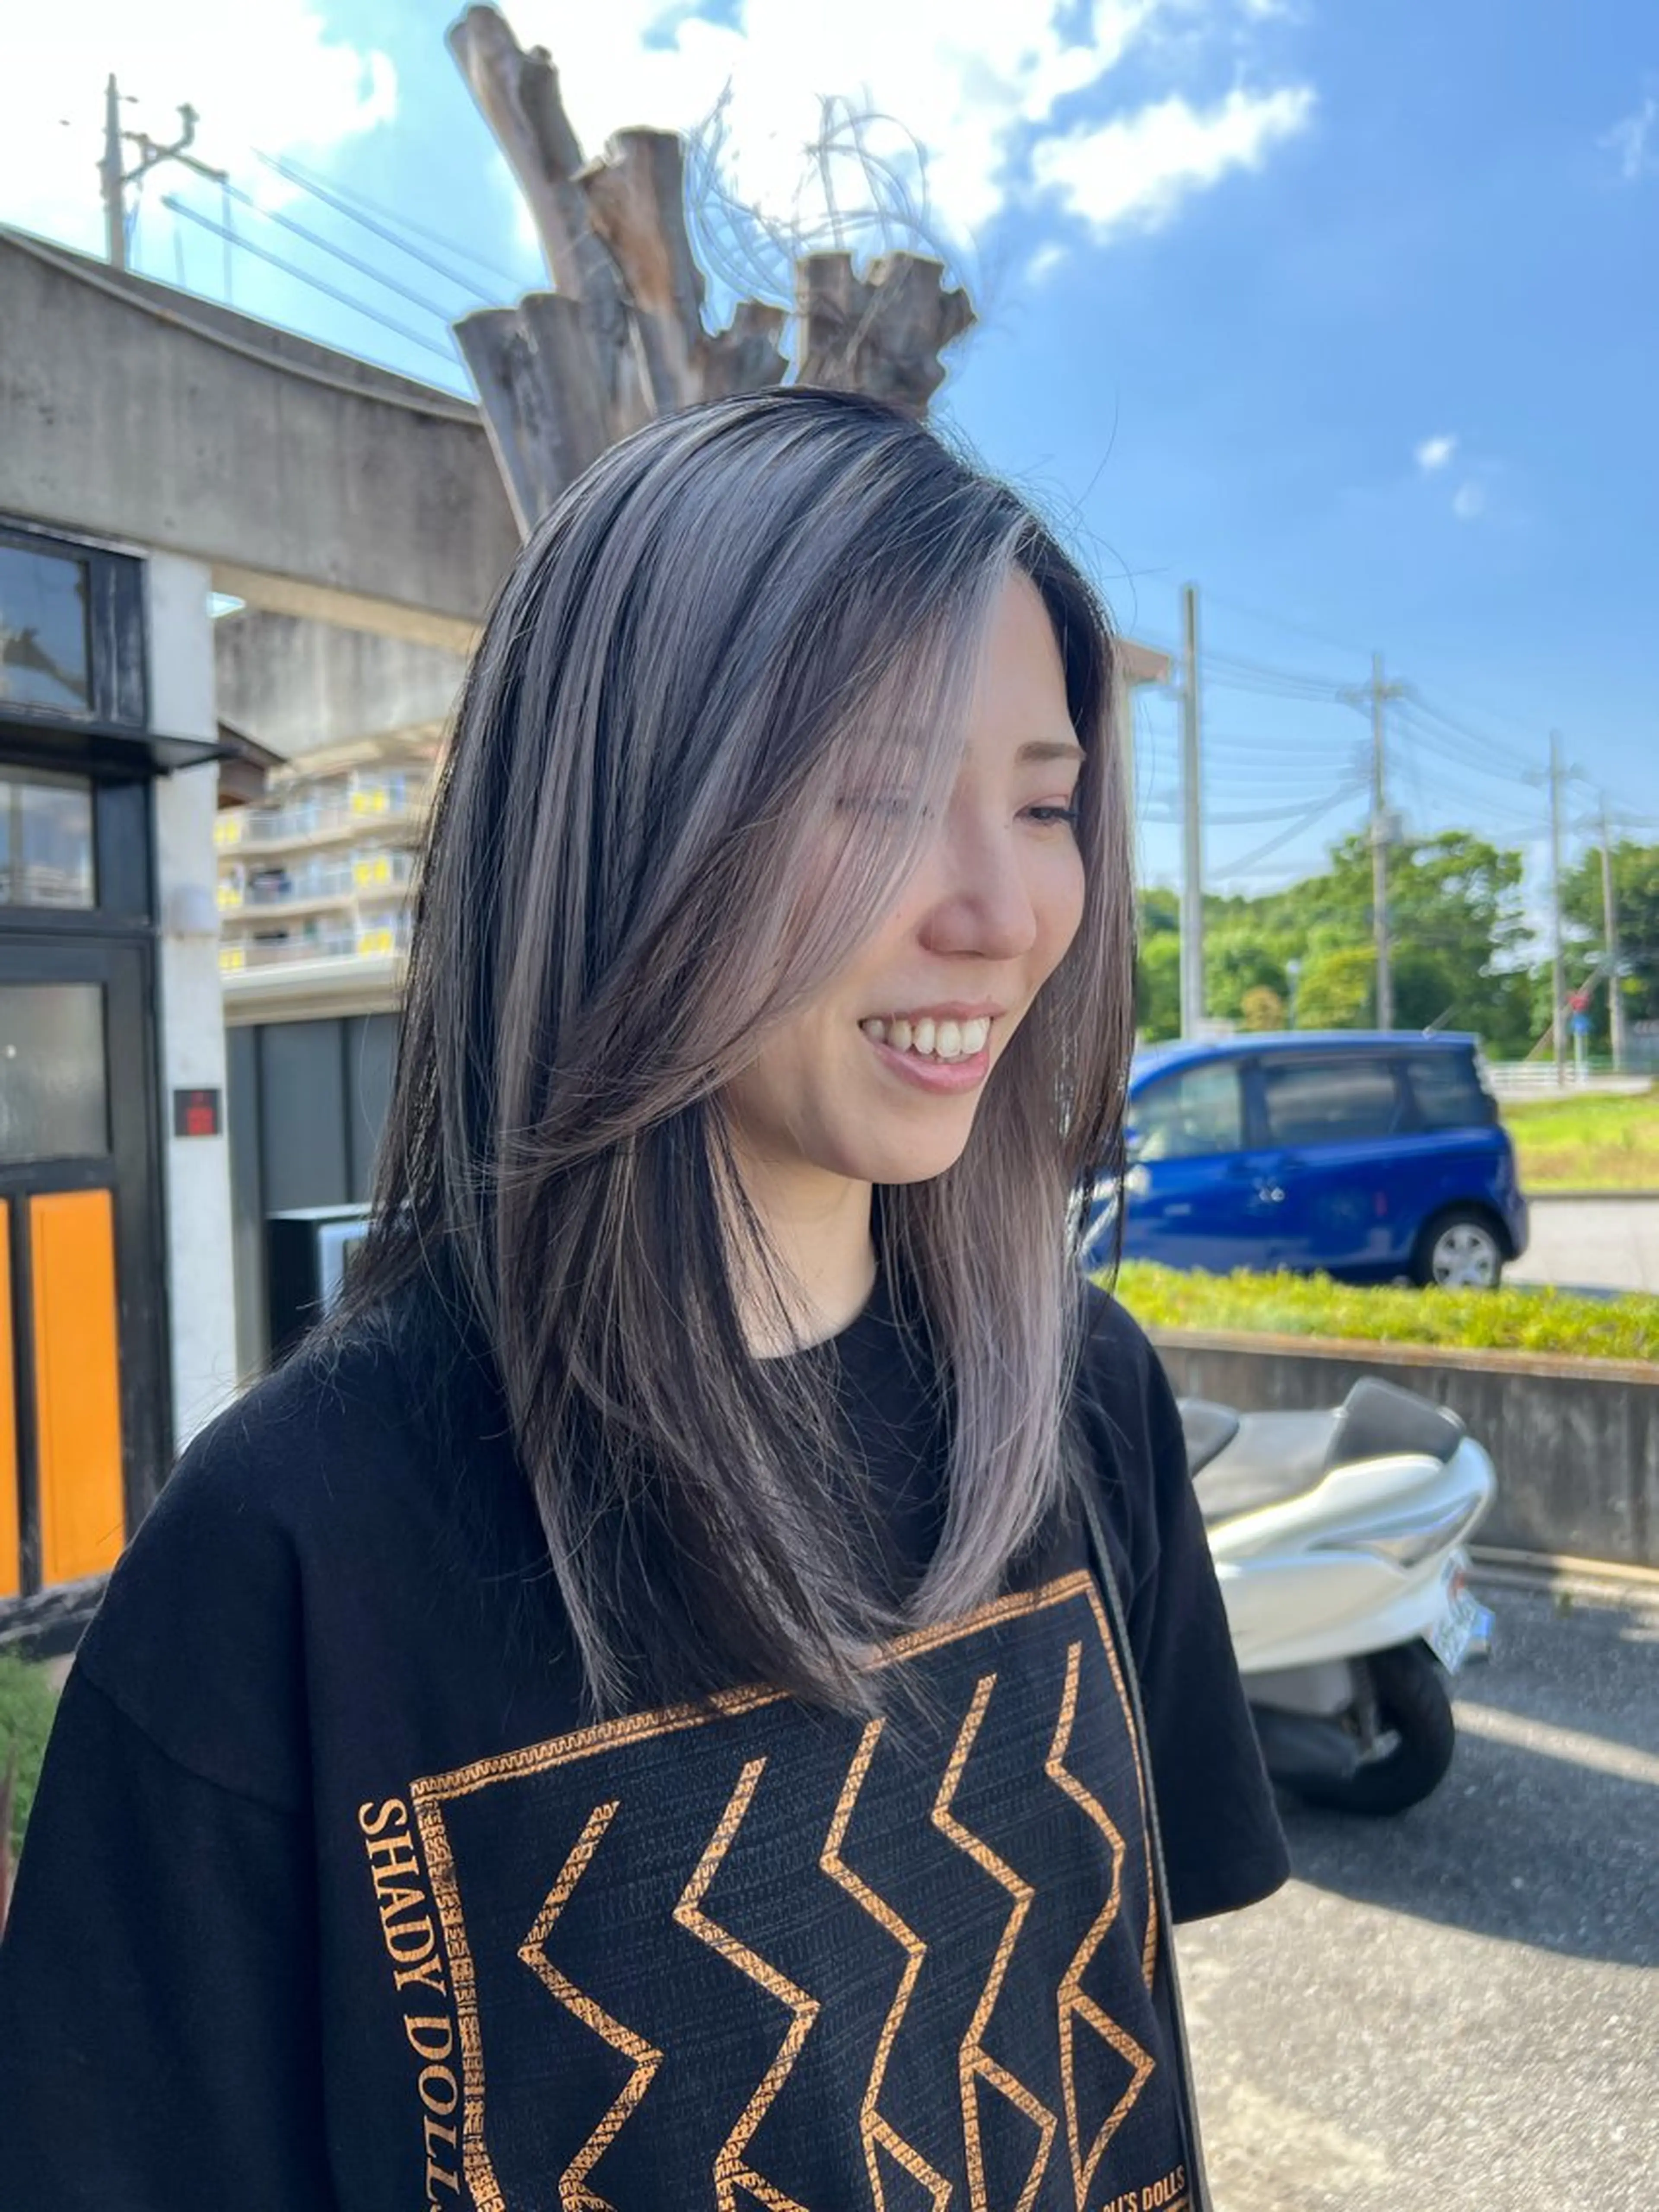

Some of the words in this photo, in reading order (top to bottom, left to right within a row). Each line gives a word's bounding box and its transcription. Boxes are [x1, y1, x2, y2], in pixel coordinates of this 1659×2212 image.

[359, 1797, 448, 1997] SHADY
[404, 2014, 461, 2212] DOLL
[1142, 2165, 1185, 2211] DOLLS
